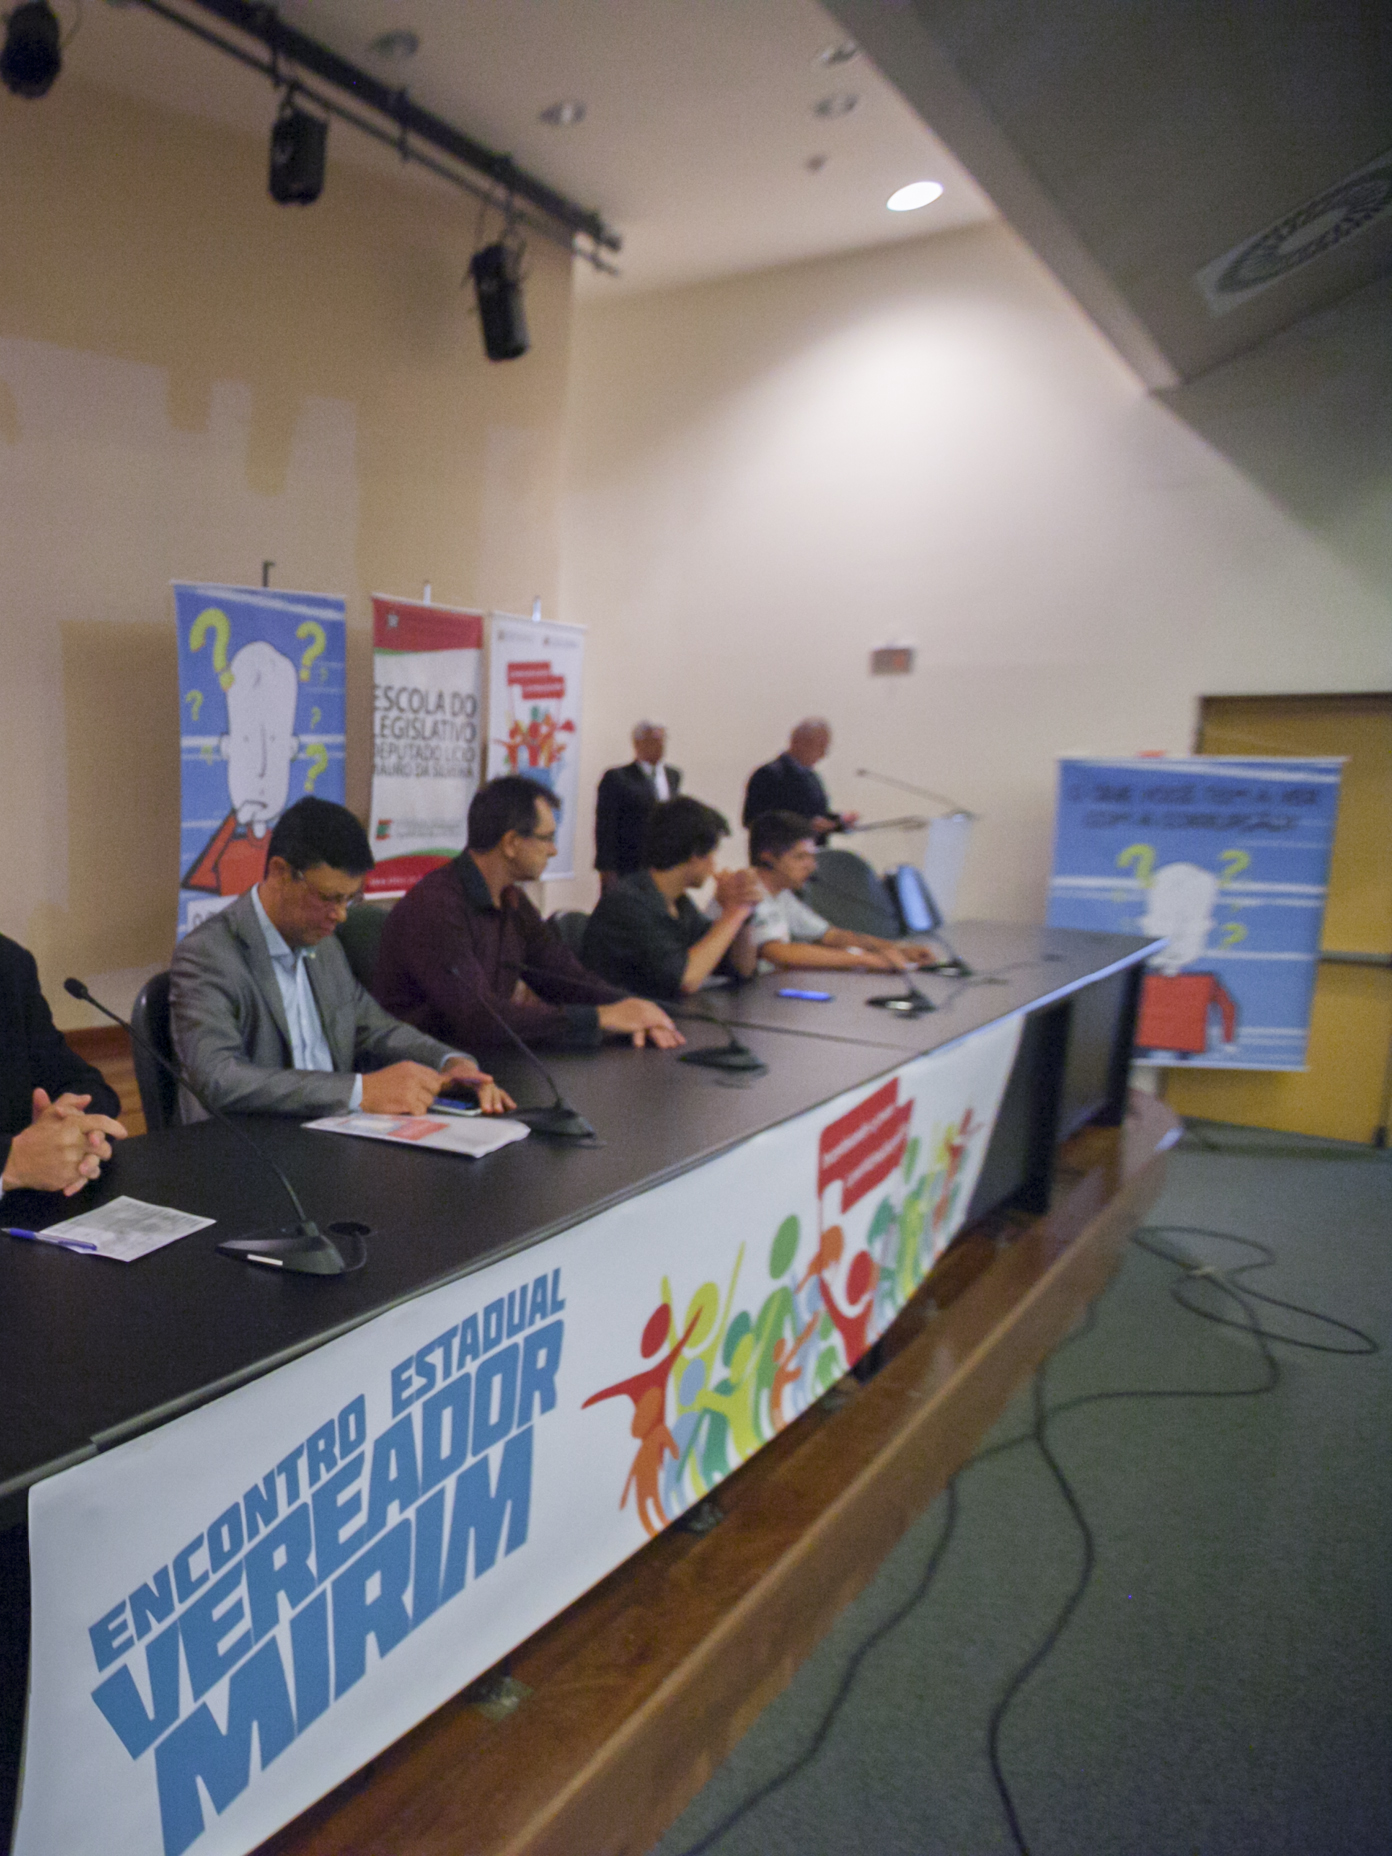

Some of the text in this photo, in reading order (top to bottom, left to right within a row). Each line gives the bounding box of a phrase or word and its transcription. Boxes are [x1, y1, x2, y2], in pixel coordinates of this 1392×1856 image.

[374, 715, 477, 744] EGISLATIVO
[450, 690, 478, 719] DO
[88, 1267, 566, 1673] ENCONTRO ESTADUAL
[90, 1319, 564, 1761] VEREADOR
[153, 1423, 535, 1856] MIRIM
